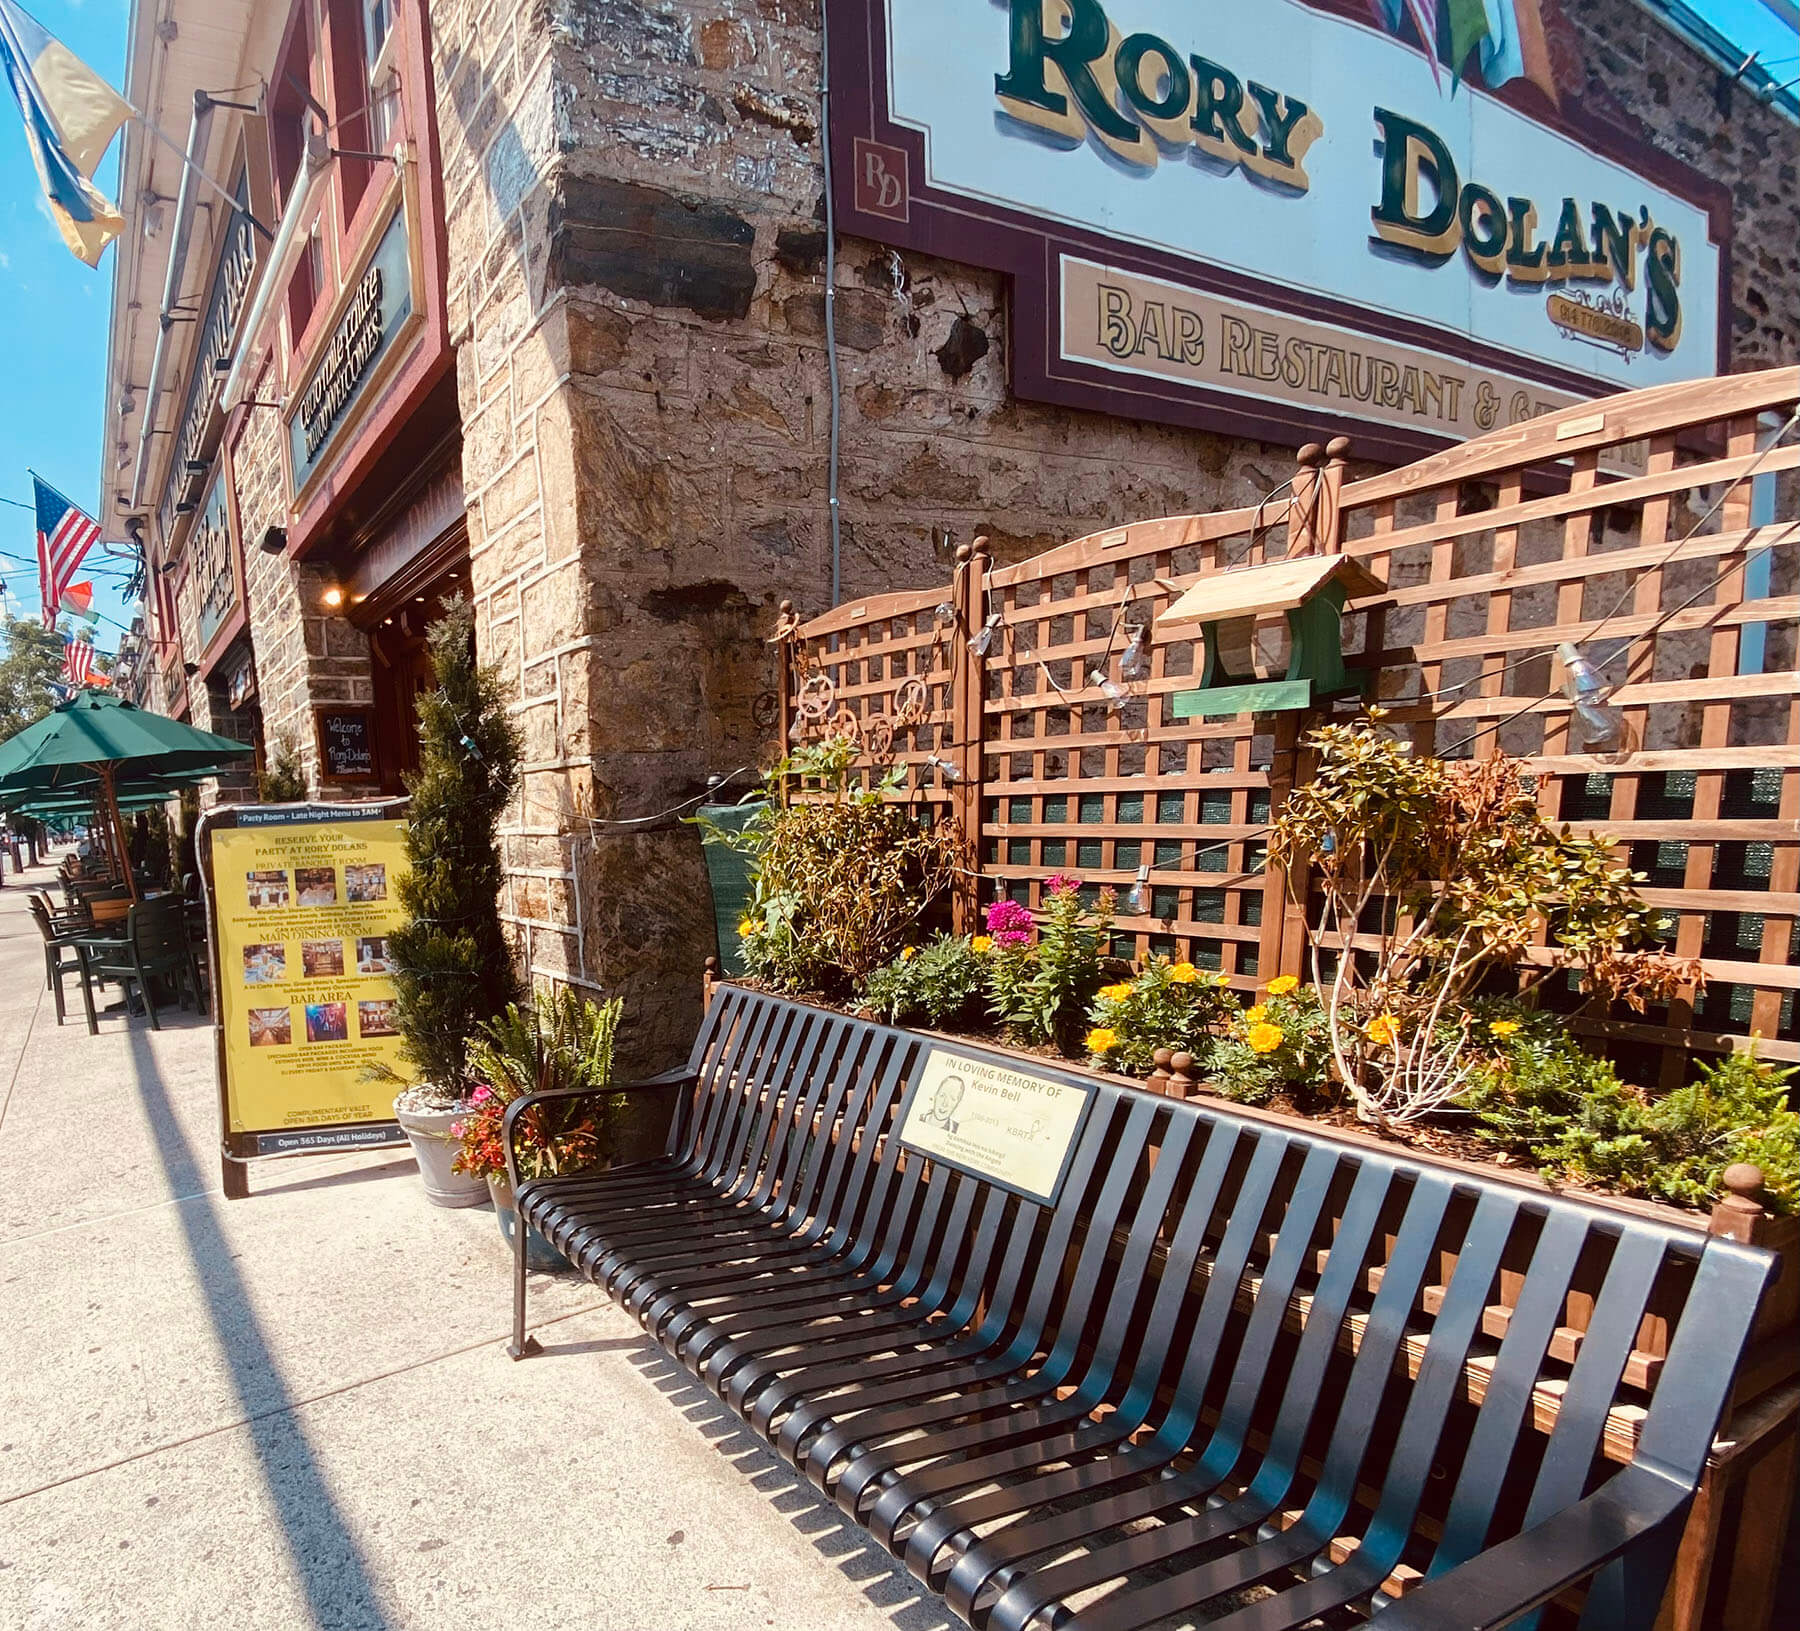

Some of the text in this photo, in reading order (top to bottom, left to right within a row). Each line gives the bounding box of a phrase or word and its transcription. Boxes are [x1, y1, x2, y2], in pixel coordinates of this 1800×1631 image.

[865, 152, 902, 208] RD
[994, 0, 1681, 348] RORY DOLAN'S
[224, 222, 254, 327] BAR
[1097, 283, 1205, 365] BAR
[1219, 314, 1465, 423] RESTAURANT
[1473, 380, 1501, 430] &
[326, 717, 363, 735] Welcome
[341, 735, 350, 746] to
[243, 812, 263, 823] Party
[263, 812, 285, 821] Room
[291, 810, 308, 820] Late
[308, 809, 330, 821] Night
[330, 807, 352, 818] Menu
[352, 808, 361, 817] to
[275, 833, 344, 845] RESERVE YOUR
[255, 846, 288, 857] PARTY
[289, 845, 303, 854] AT
[304, 843, 332, 853] RORY
[256, 861, 292, 870] PRIVATE
[295, 858, 336, 867] BANQUET
[338, 856, 367, 864] ROOM
[259, 927, 373, 942] MAIN DINING ROOM
[290, 991, 353, 1004] BAR AREA
[945, 1058, 1063, 1099] IN LOVING MEMORY OF
[970, 1079, 1021, 1102] Kevin Bell
[283, 1117, 304, 1125] OPEN
[321, 1113, 342, 1121] DAYS
[354, 1111, 373, 1119] YEAR
[287, 1104, 370, 1117] COMPLIMENTARY VALET
[278, 1130, 387, 1147] Open 365 Days (All Holidays)
